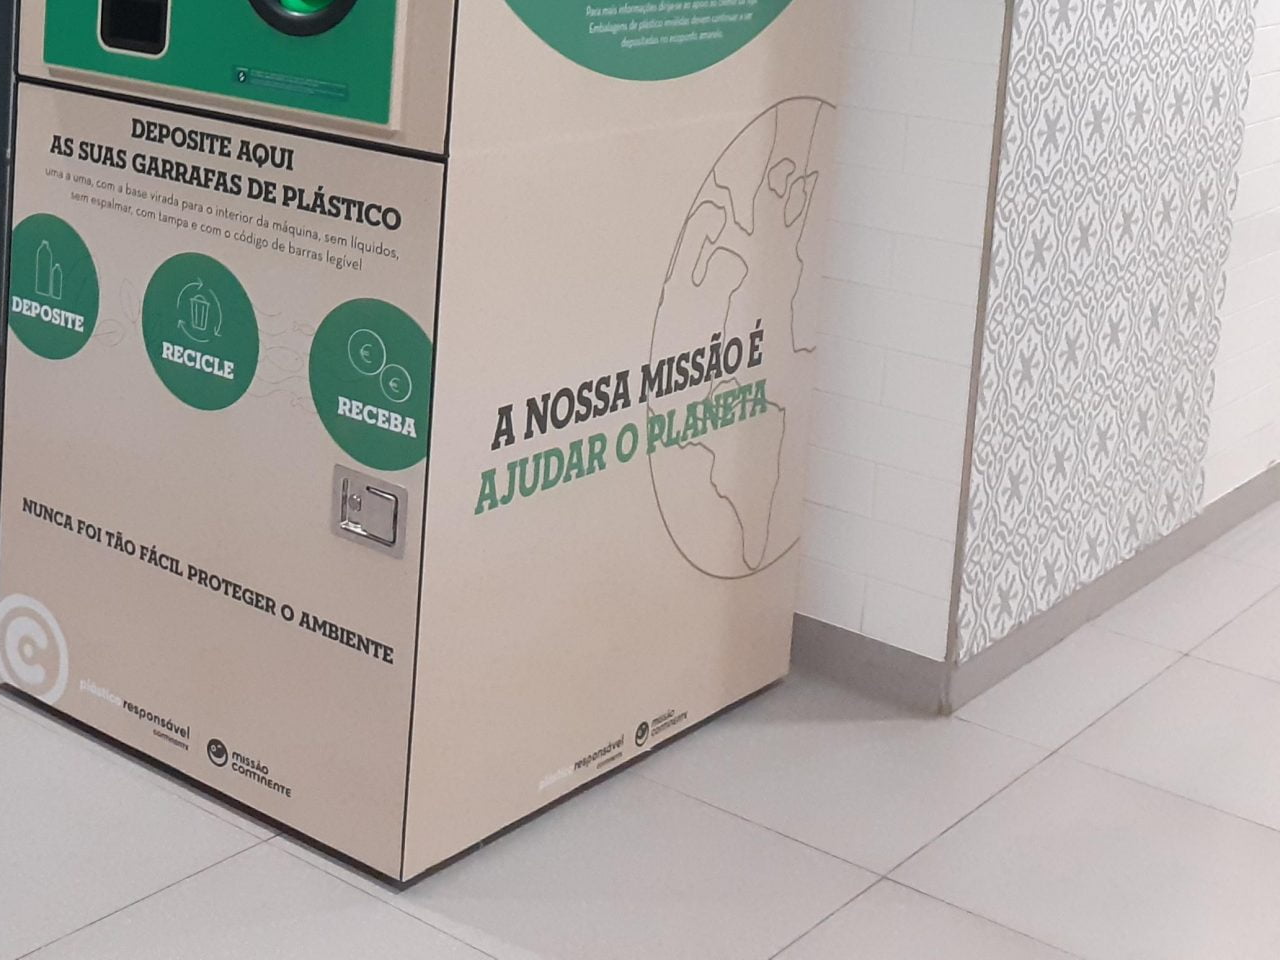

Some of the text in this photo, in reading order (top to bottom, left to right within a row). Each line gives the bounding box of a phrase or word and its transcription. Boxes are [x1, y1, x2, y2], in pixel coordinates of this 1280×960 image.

[50, 134, 402, 231] AS SUAS GARRAFAS DE PLÁSTICO
[131, 118, 294, 171] DEPOSITE AQUI
[45, 167, 400, 261] uma a uma, com a base virada para o interior da máquina, sem líquidos,
[70, 191, 363, 271] sem espalmar, com tampa e com o código de barras legível
[11, 296, 84, 333] DEPOSITE
[161, 341, 235, 380] RECICLE
[490, 318, 764, 451] A NOSSA MISSÃO É
[337, 395, 417, 438] RECEBA
[474, 379, 768, 516] AJUDAR O PLANETA
[22, 496, 395, 665] NUNCA FOI TÃO FÁCIL PROTEGER O AMBIENTE
[123, 698, 190, 740] responsável
